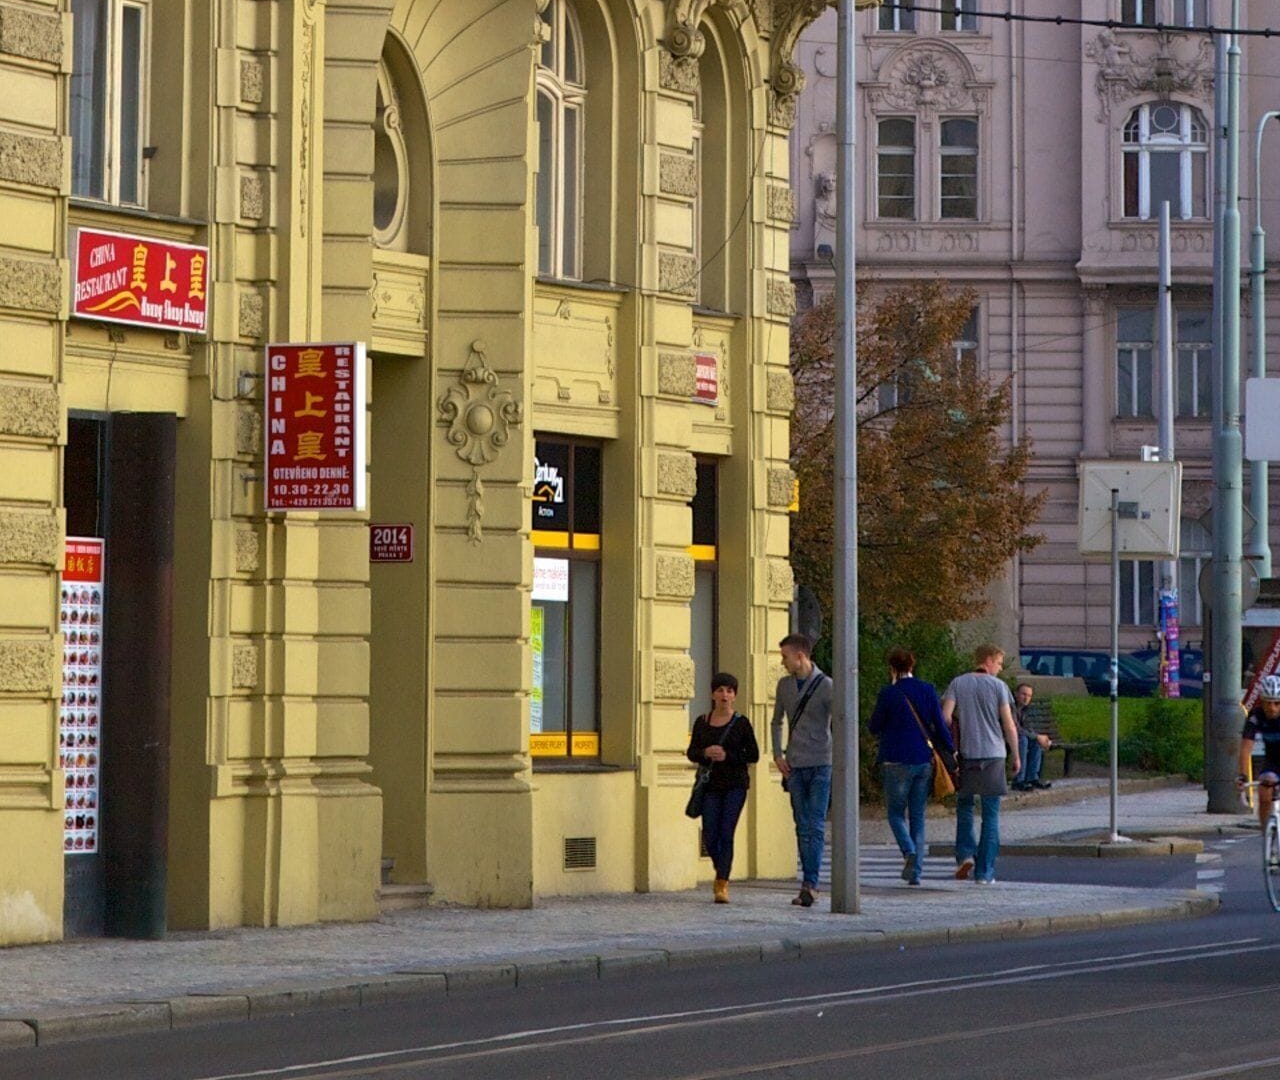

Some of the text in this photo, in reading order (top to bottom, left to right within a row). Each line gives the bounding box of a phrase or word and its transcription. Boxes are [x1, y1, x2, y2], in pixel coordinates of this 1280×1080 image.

[90, 242, 116, 268] CHINA
[130, 242, 205, 300] 皇上皇
[76, 267, 128, 301] RESTAURANT
[271, 355, 286, 455] CHINA
[293, 348, 327, 461] 皇上皇
[334, 347, 350, 457] RESTAURANT
[273, 466, 318, 480] OTEVŘENO
[374, 528, 407, 544] 2014
